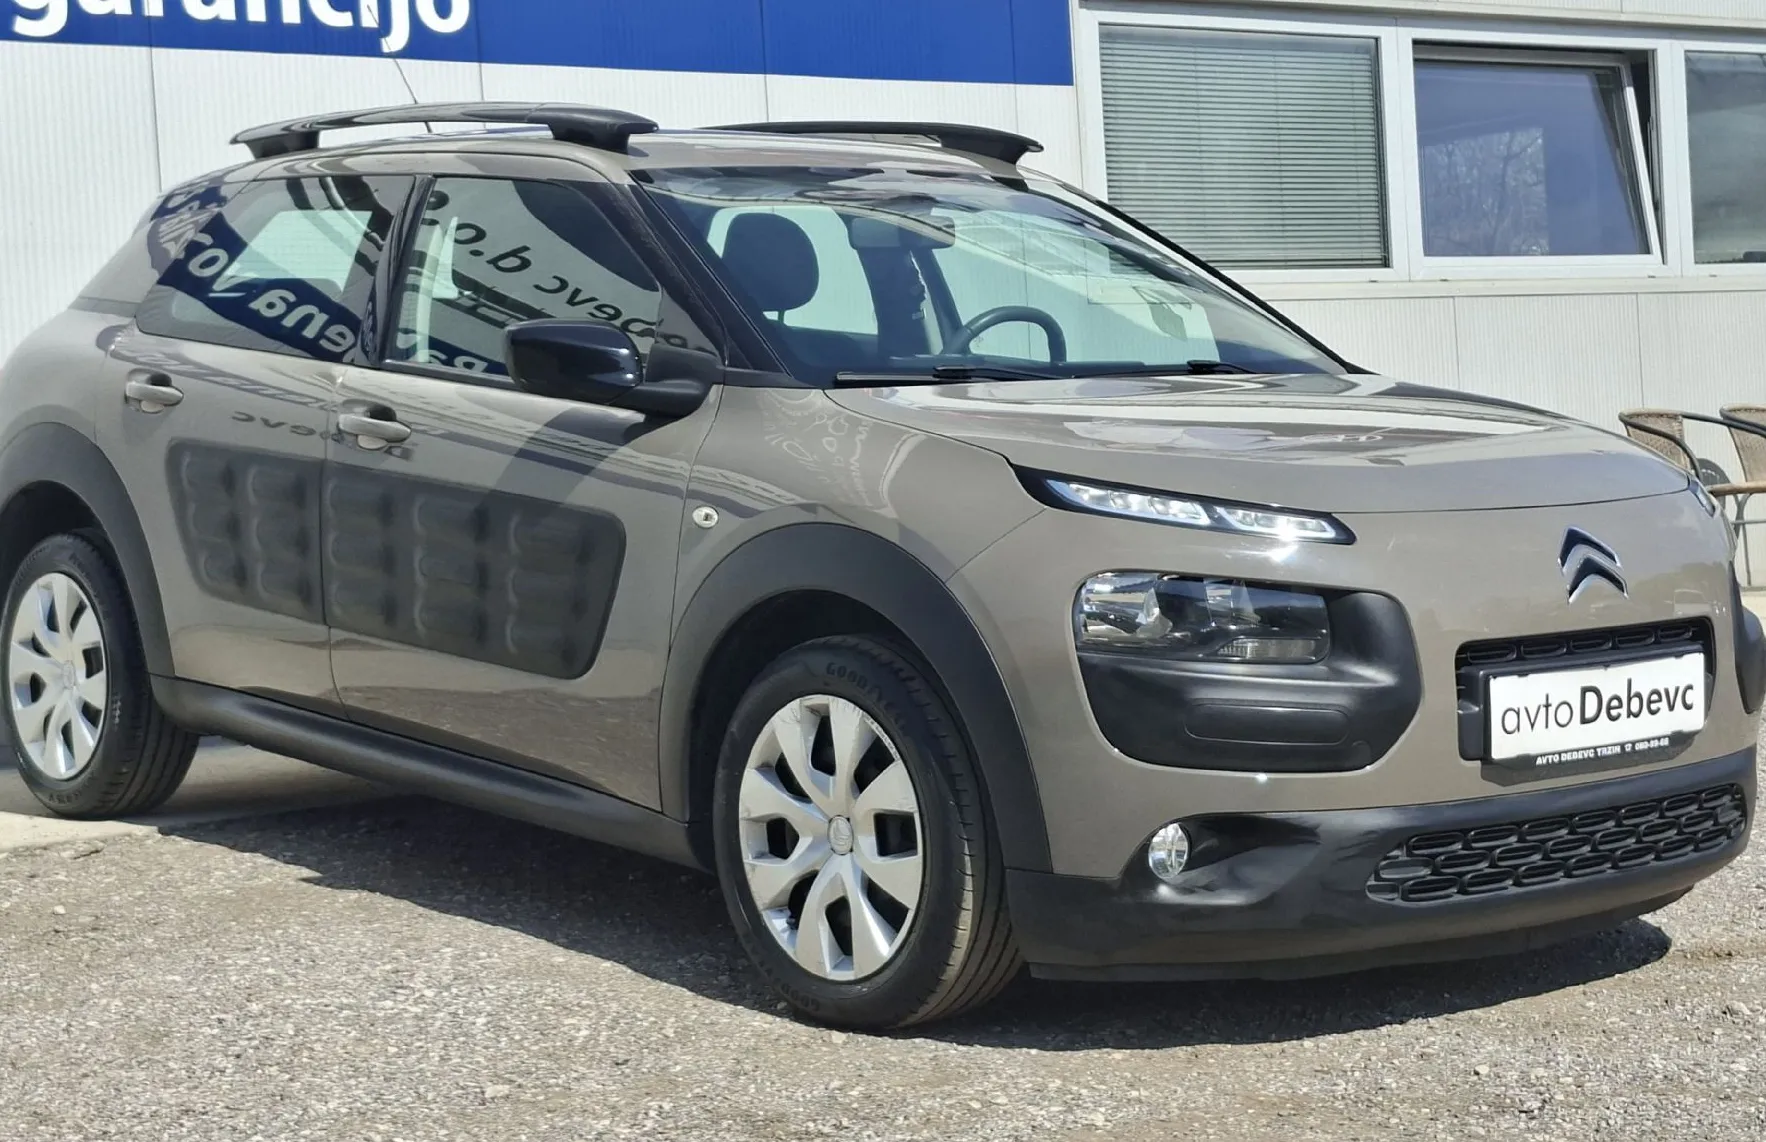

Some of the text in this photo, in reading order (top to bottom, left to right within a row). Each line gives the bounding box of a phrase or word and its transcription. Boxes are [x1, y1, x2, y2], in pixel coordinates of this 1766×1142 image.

[12, 0, 471, 53] gcijo
[1501, 678, 1695, 735] avto Debevc
[1535, 754, 1560, 766] AVTO
[1560, 749, 1596, 762] DEBEVC
